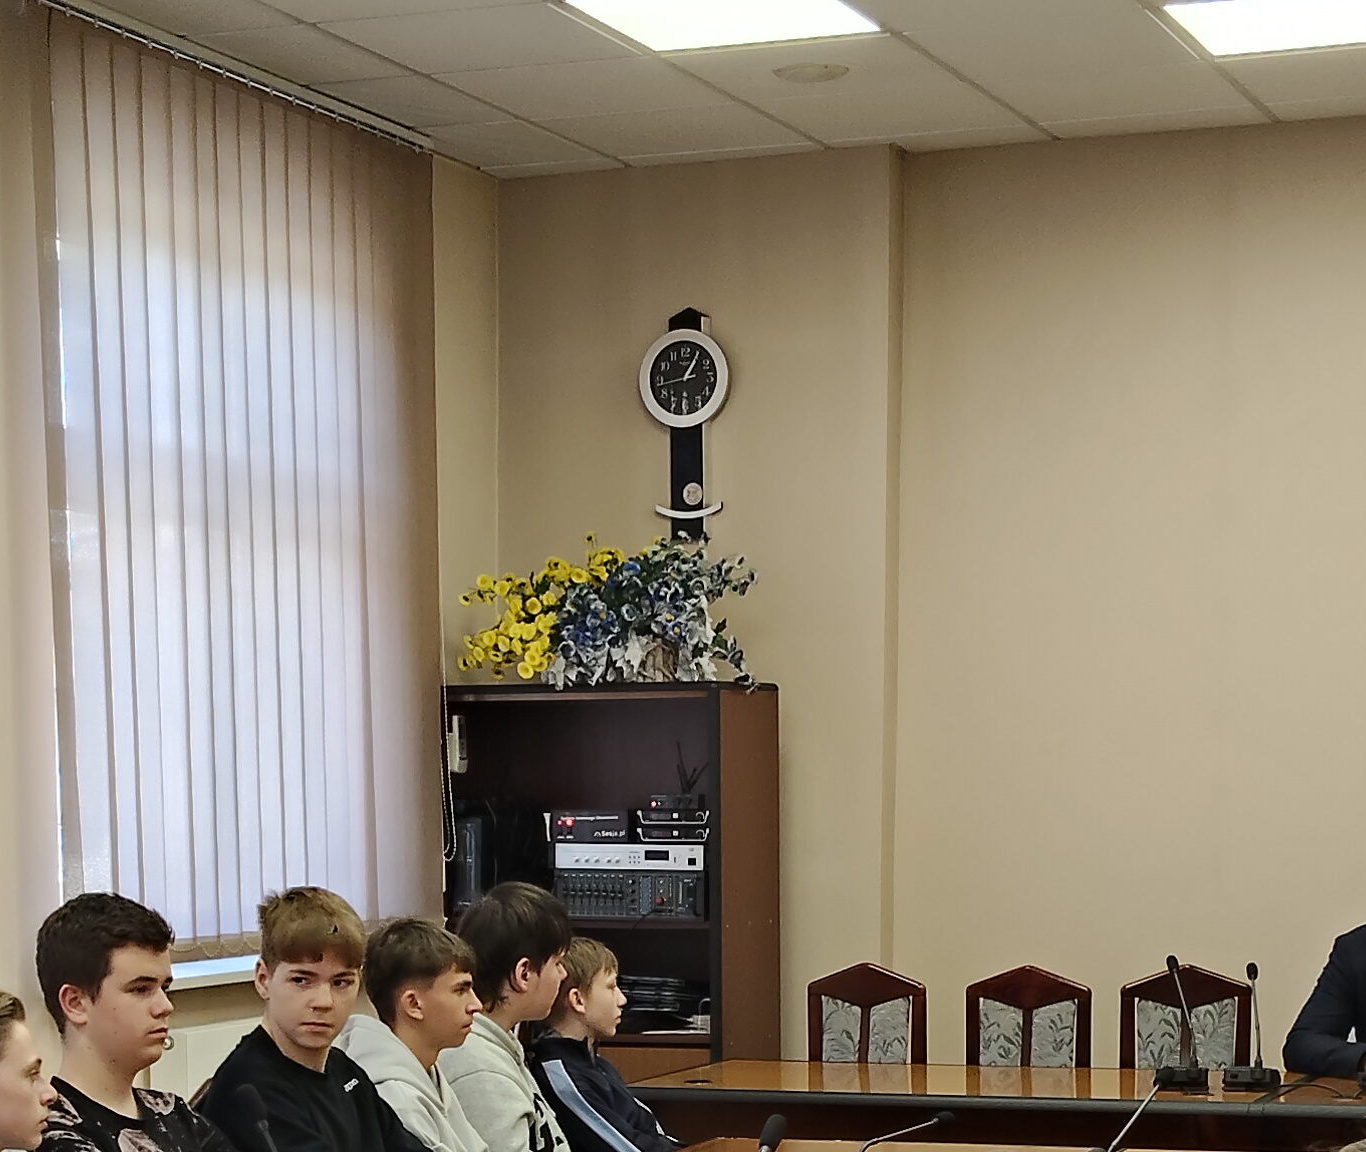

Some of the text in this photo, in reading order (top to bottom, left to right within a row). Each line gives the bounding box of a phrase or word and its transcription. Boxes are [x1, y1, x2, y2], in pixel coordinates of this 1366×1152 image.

[670, 351, 677, 361] 11
[680, 347, 691, 357] 12
[660, 361, 670, 371] 10
